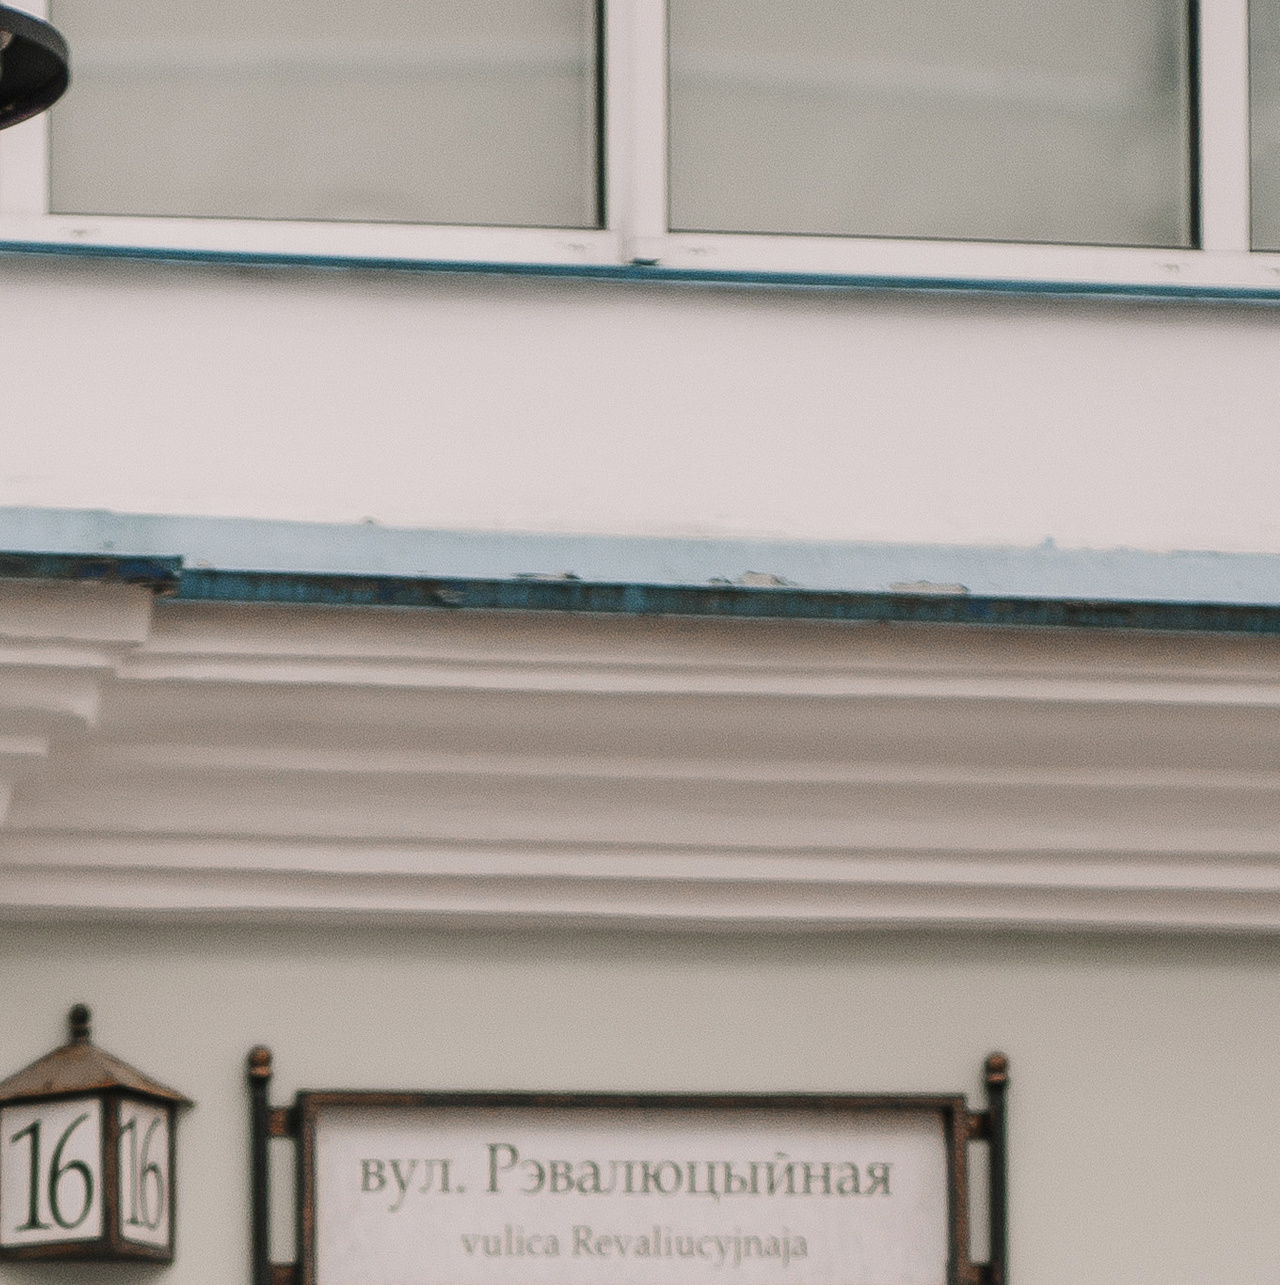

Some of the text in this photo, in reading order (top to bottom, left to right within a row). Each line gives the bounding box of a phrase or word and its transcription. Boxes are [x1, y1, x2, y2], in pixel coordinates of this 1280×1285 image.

[10, 1113, 94, 1231] 16
[120, 1116, 164, 1230] 16
[360, 1142, 894, 1213] вул. Рэвалюцыйная
[460, 1224, 808, 1269] vulica Revaliucyjnaja
